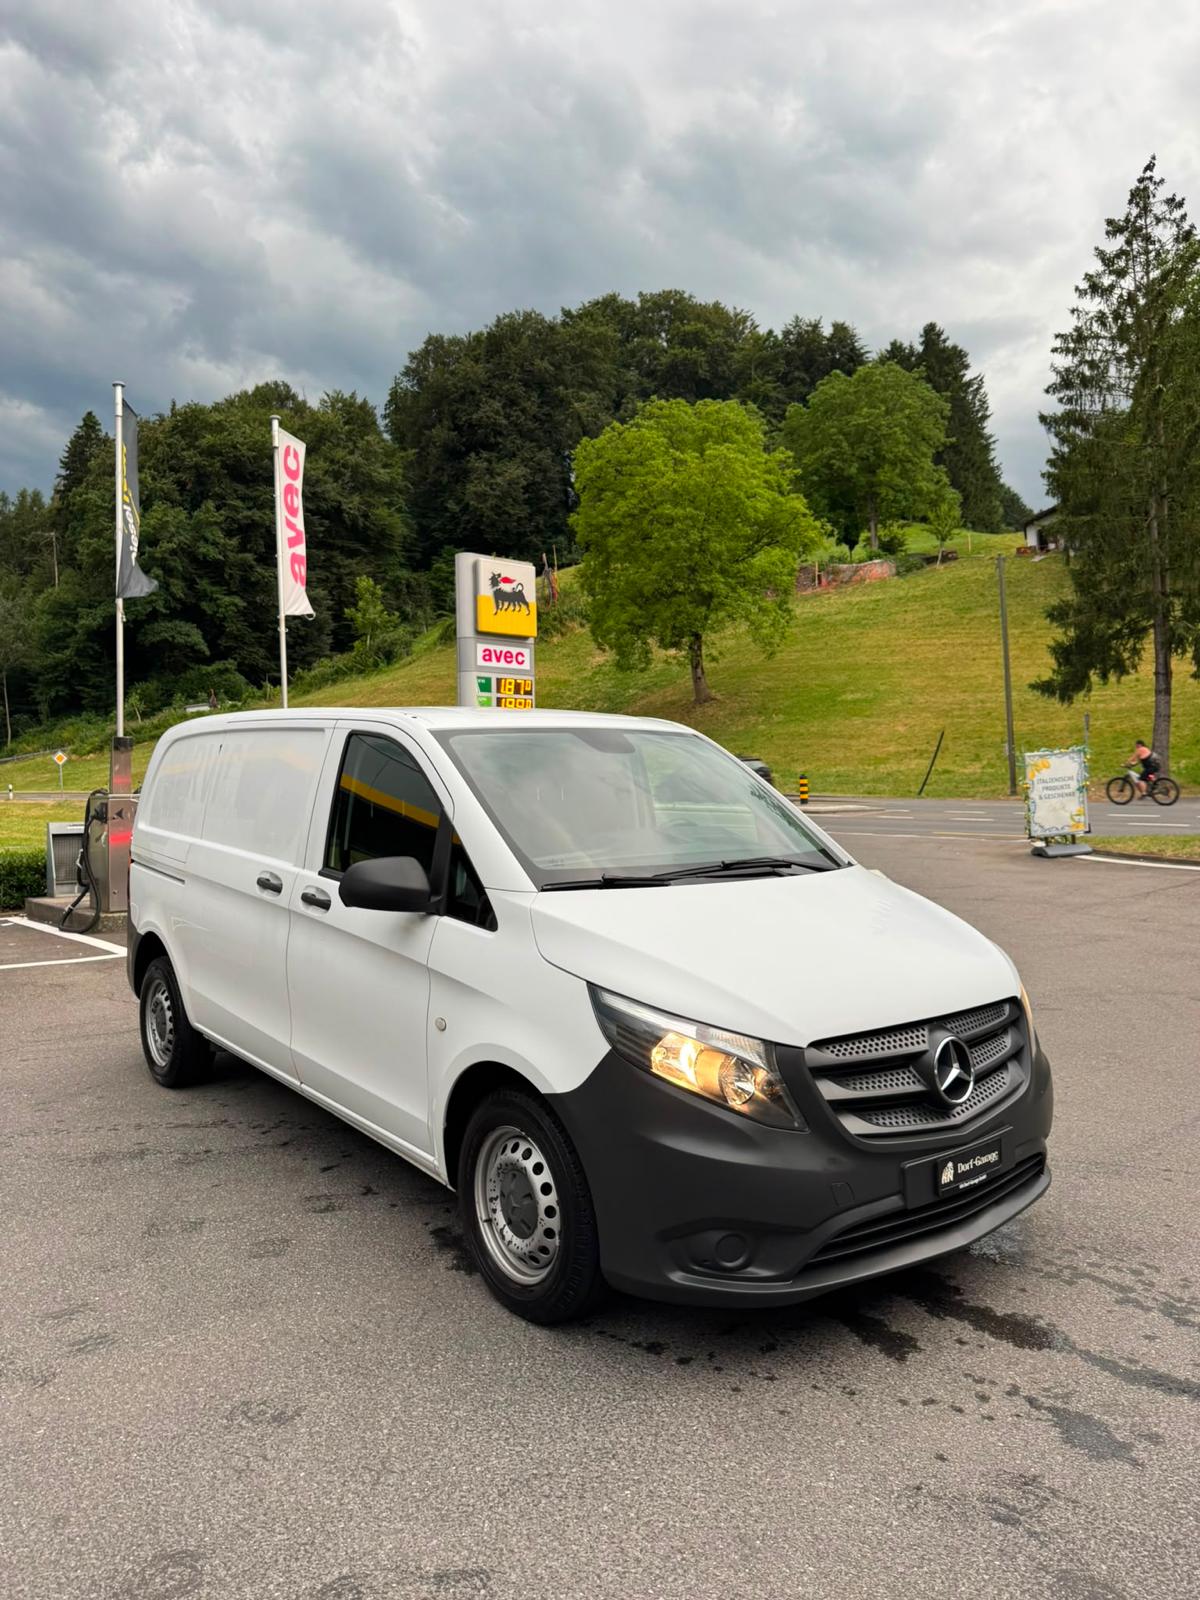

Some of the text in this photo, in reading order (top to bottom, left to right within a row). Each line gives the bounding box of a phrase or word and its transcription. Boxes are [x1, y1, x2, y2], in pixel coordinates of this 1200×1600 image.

[284, 445, 306, 587] avec
[482, 648, 525, 665] avec
[957, 1151, 998, 1173] Dorf-Garage
